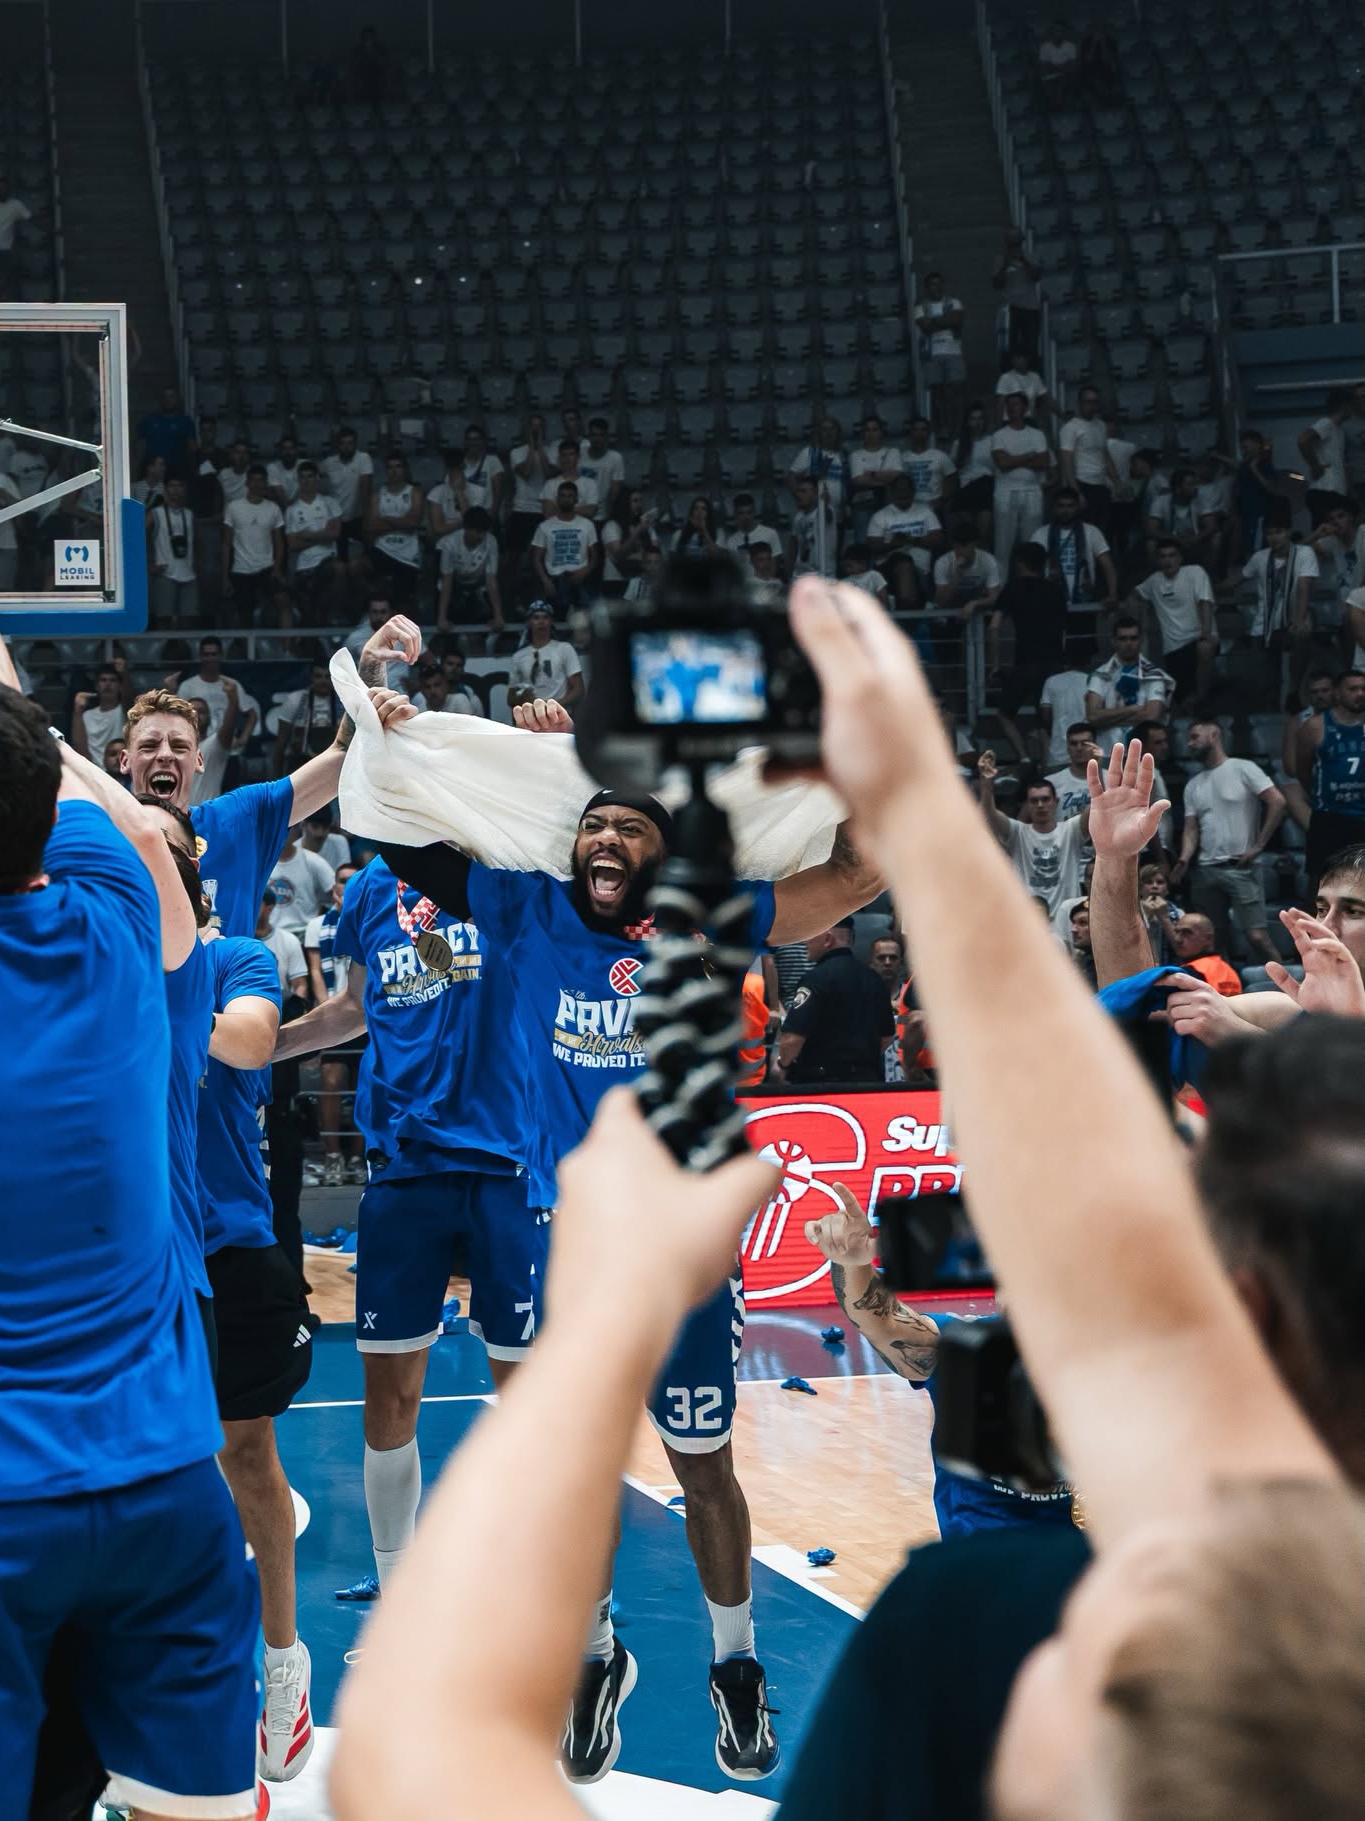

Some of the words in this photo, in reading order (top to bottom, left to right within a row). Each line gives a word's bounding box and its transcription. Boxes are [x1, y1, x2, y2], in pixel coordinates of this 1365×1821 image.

[60, 567, 95, 575] MOBIL
[1347, 756, 1360, 775] 7
[553, 1043, 571, 1062] WE
[574, 1051, 626, 1068] PROVED
[666, 1386, 723, 1429] 32
